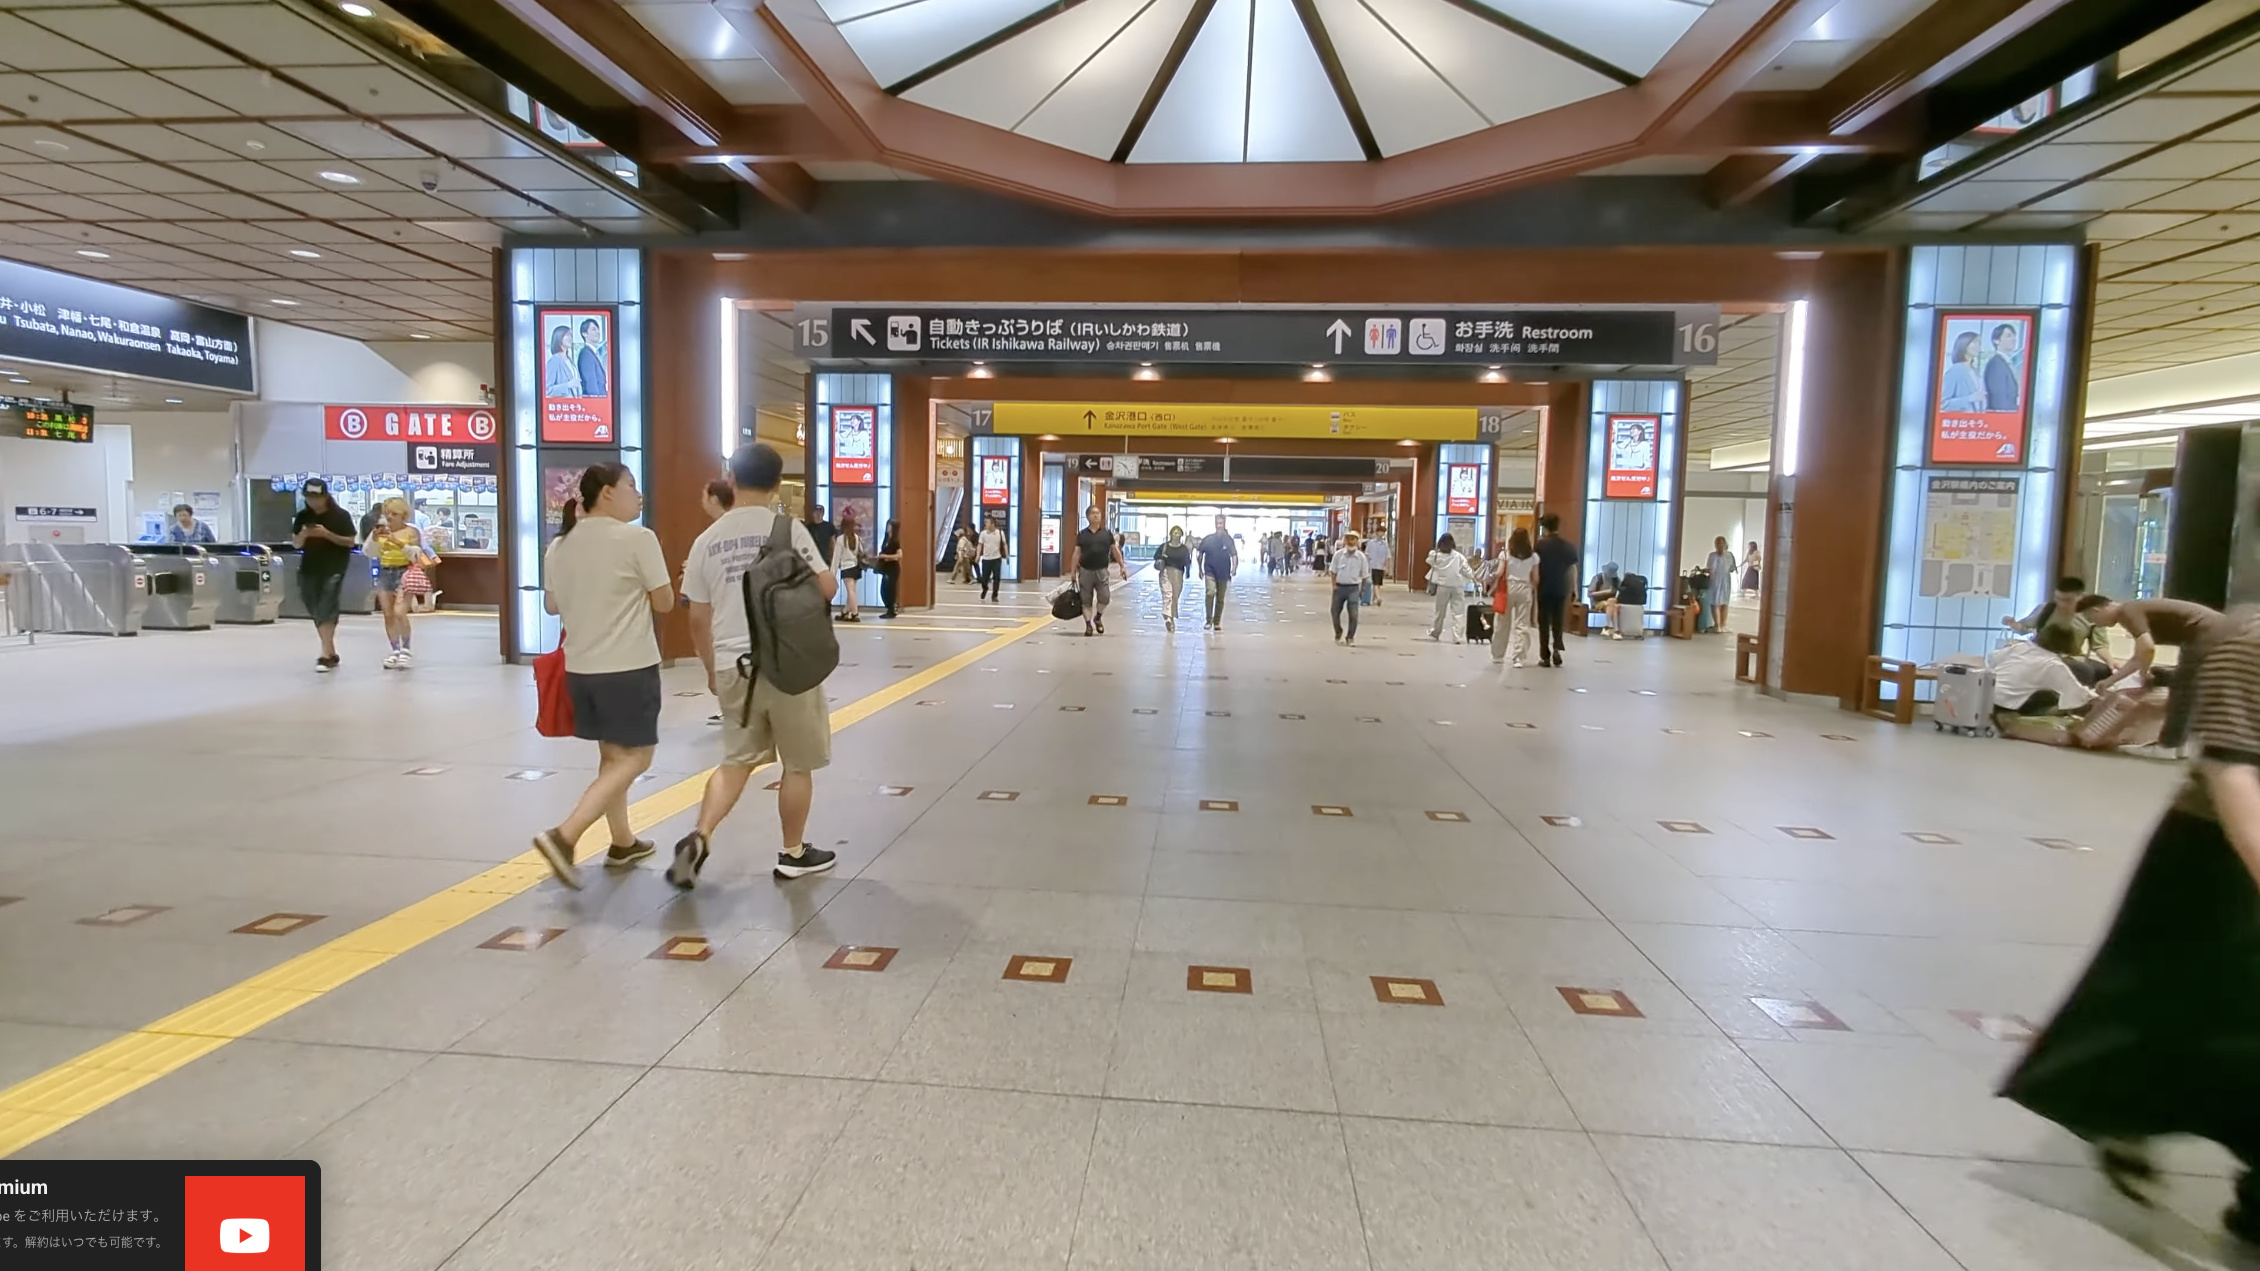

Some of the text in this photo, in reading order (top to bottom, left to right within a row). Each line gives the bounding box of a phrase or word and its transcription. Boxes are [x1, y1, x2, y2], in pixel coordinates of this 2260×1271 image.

[798, 318, 829, 347] 15
[929, 317, 1064, 337] 自動きっぷうりば
[1455, 320, 1593, 340] お手洗 Restroom
[13, 314, 59, 335] Tsubata,
[61, 324, 97, 343] Nanao,
[98, 330, 162, 352] Wakuraonsen
[166, 343, 204, 361] Takaoka,
[204, 350, 239, 366] Toyama)
[930, 337, 1100, 354] Tickets (IR Ishikawa Railway)
[1678, 323, 1716, 353] 16
[972, 409, 992, 426] 17
[1105, 411, 1147, 422] 金沢港口
[1942, 418, 1989, 429] 動き出そう。
[1137, 423, 1151, 431] Port
[1151, 423, 1167, 431] Gate
[1479, 415, 1500, 434] 18
[440, 448, 475, 461] 精算所
[455, 461, 490, 469] Adjustment
[1067, 458, 1079, 469] 19
[1375, 462, 1390, 474] 20
[1497, 500, 1517, 508] VIA
